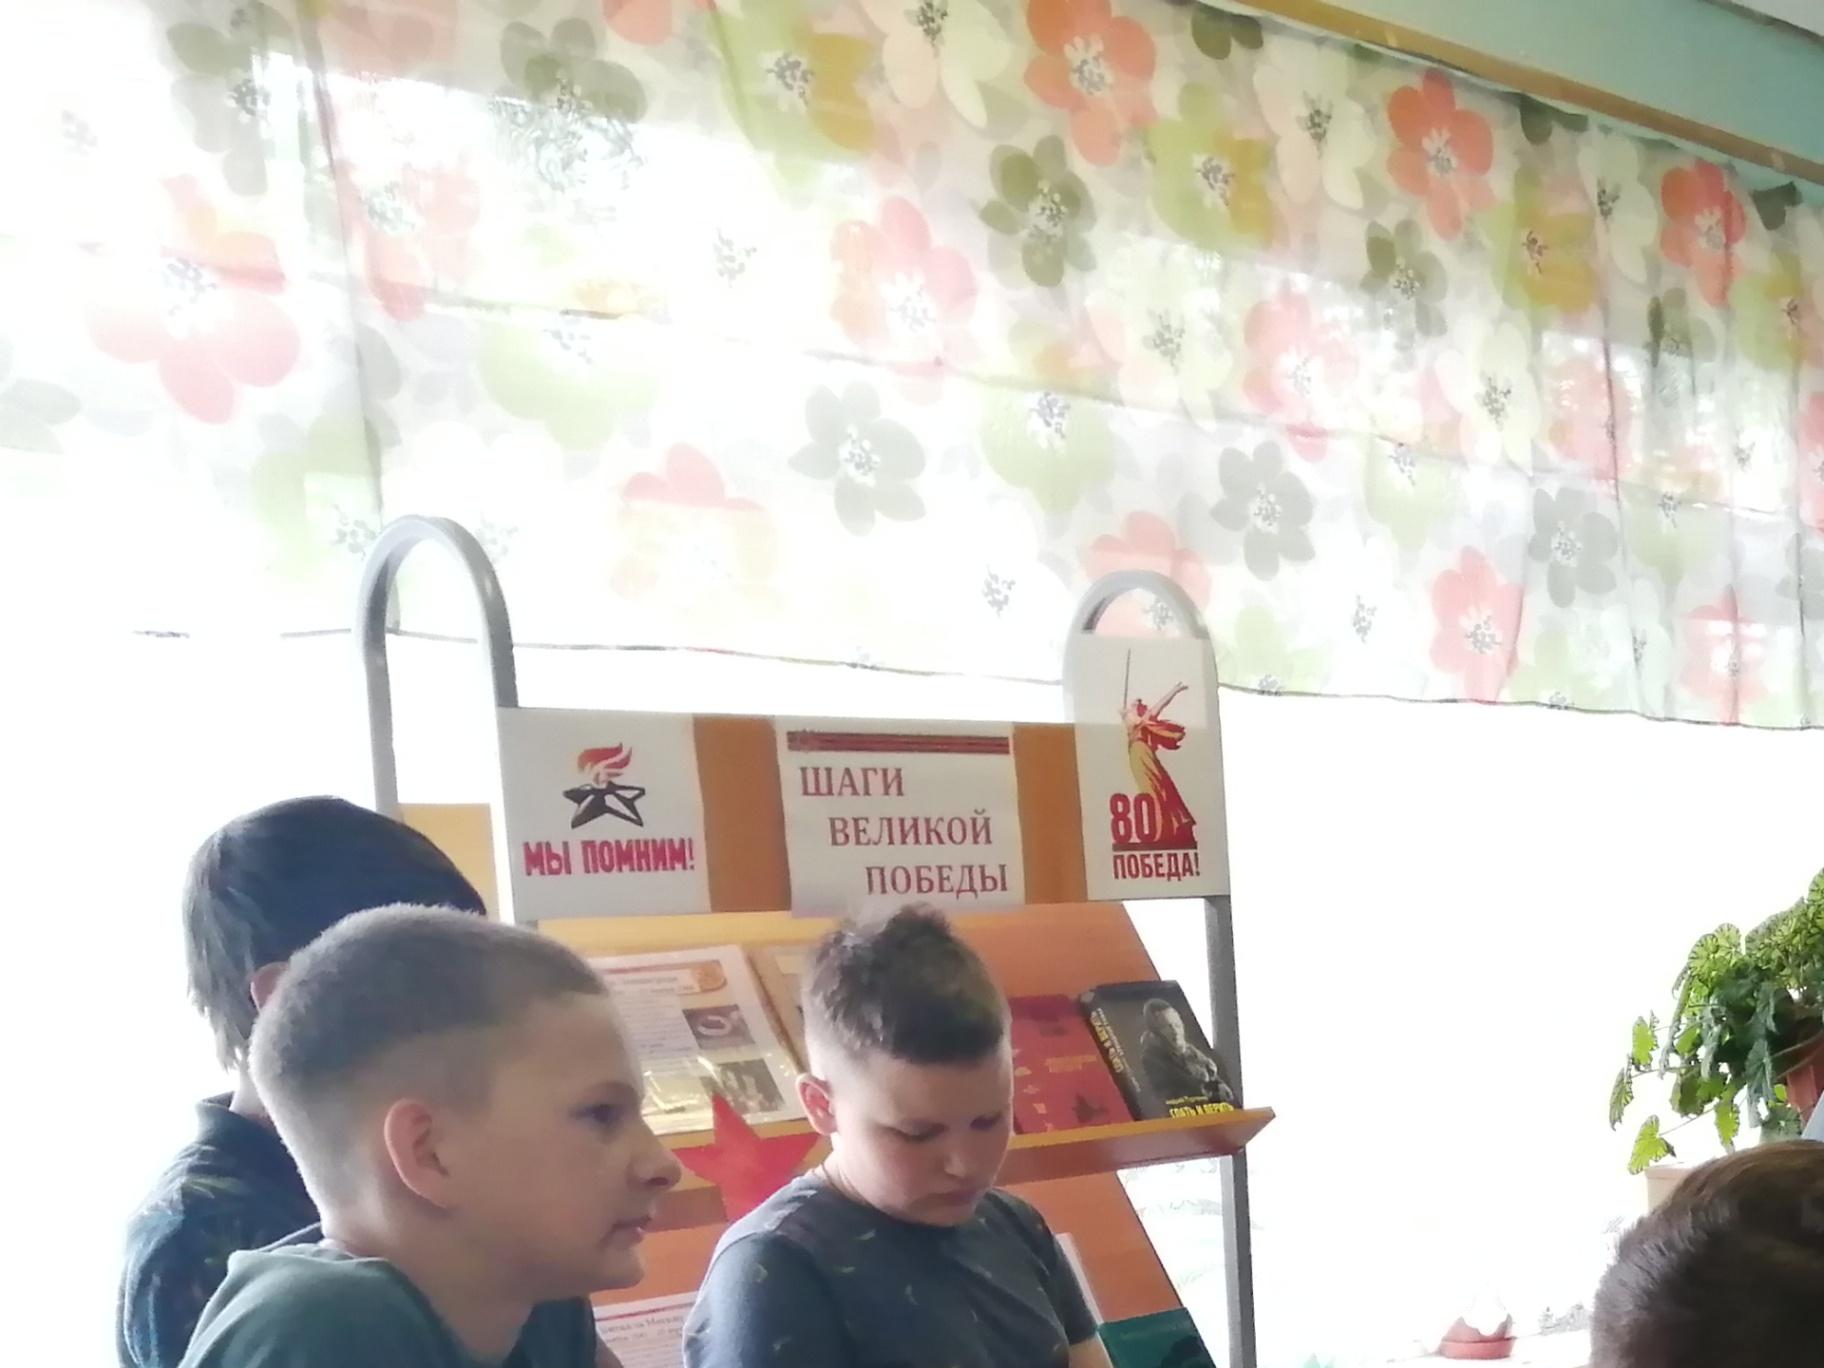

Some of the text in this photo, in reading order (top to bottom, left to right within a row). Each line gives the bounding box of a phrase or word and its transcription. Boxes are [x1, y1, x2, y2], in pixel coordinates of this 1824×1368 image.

[800, 766, 905, 797] ШАГИ
[828, 808, 993, 847] ВЕЛИКОЙ
[1109, 792, 1158, 844] 80
[523, 837, 696, 877] МЫ ПОМНИМ!
[1112, 851, 1201, 882] ПОБЕДА!
[865, 863, 1009, 900] ПОБЕДЫ
